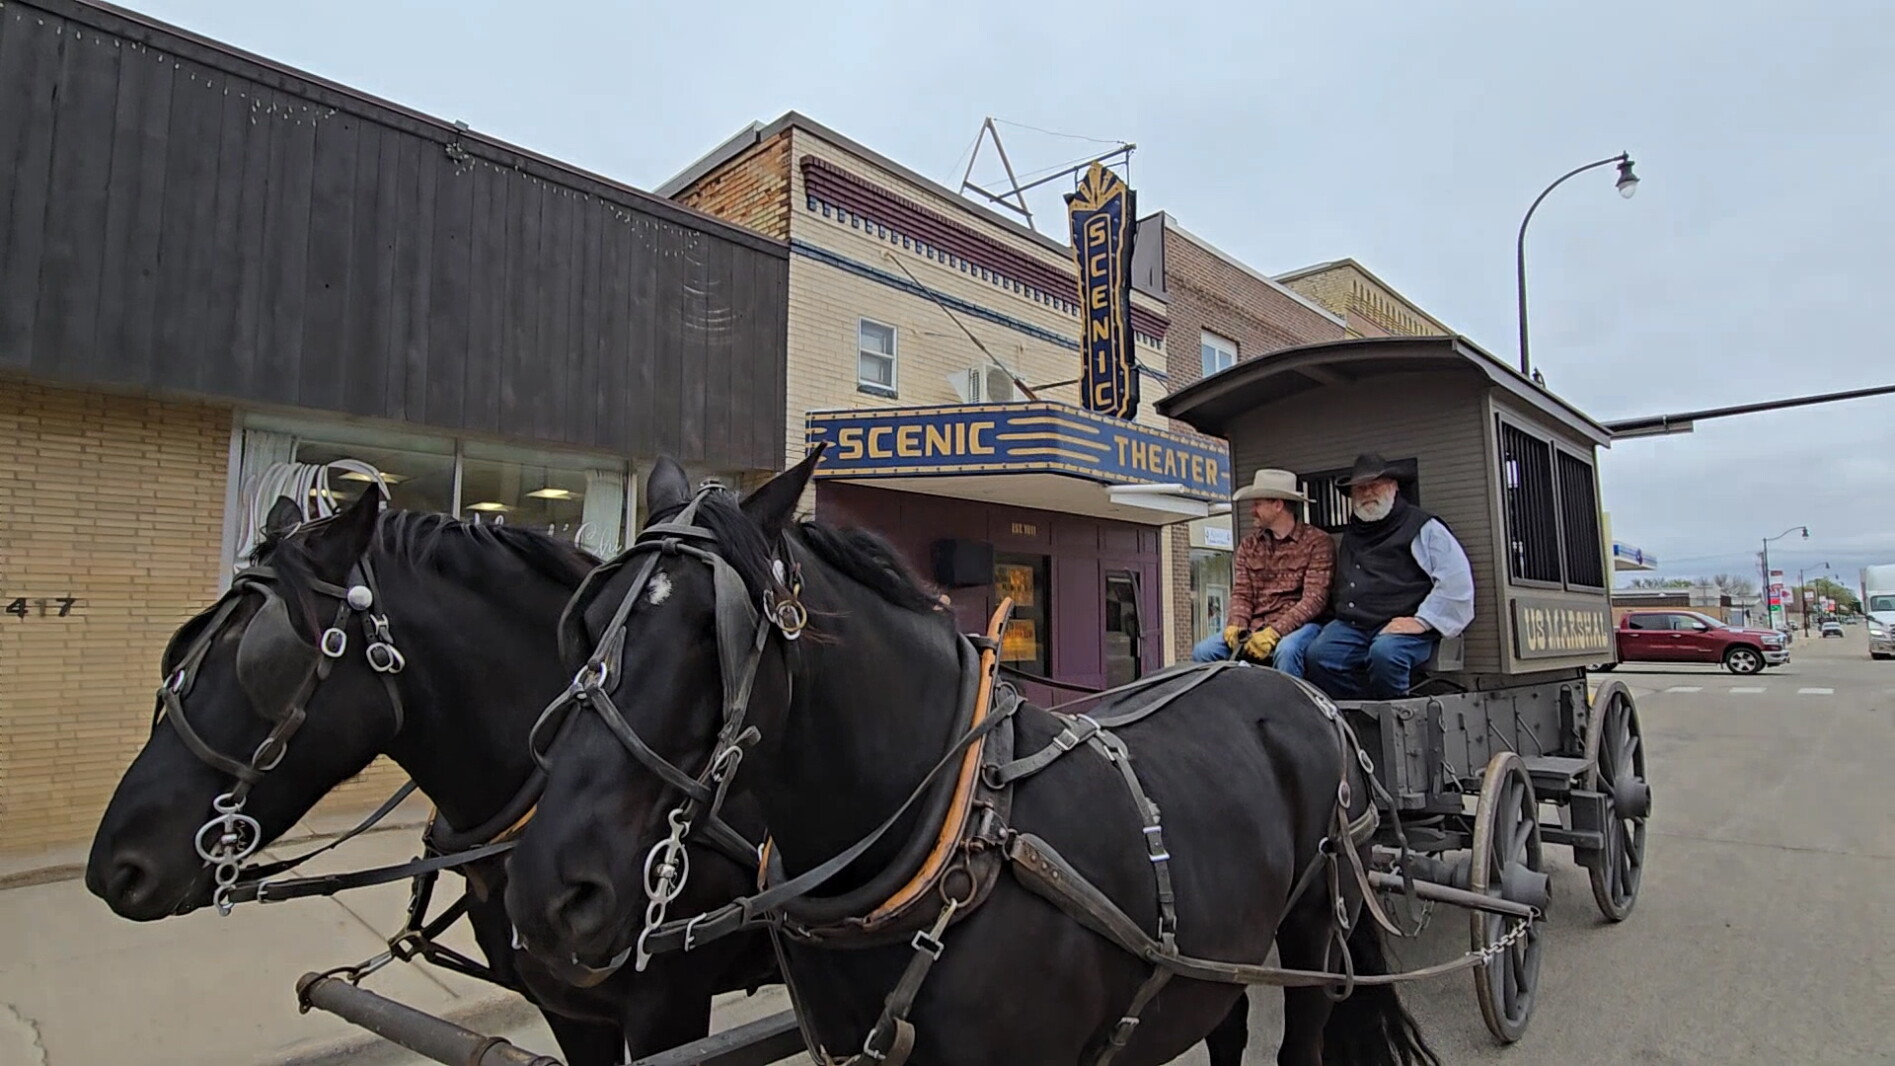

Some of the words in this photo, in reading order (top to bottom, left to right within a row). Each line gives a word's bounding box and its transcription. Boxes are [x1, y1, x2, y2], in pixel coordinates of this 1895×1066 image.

[1088, 220, 1112, 407] SCENIC
[838, 421, 996, 460] SCENIC
[1113, 434, 1219, 487] THEATER
[5, 597, 77, 619] 417
[1545, 608, 1609, 650] MARSHAL
